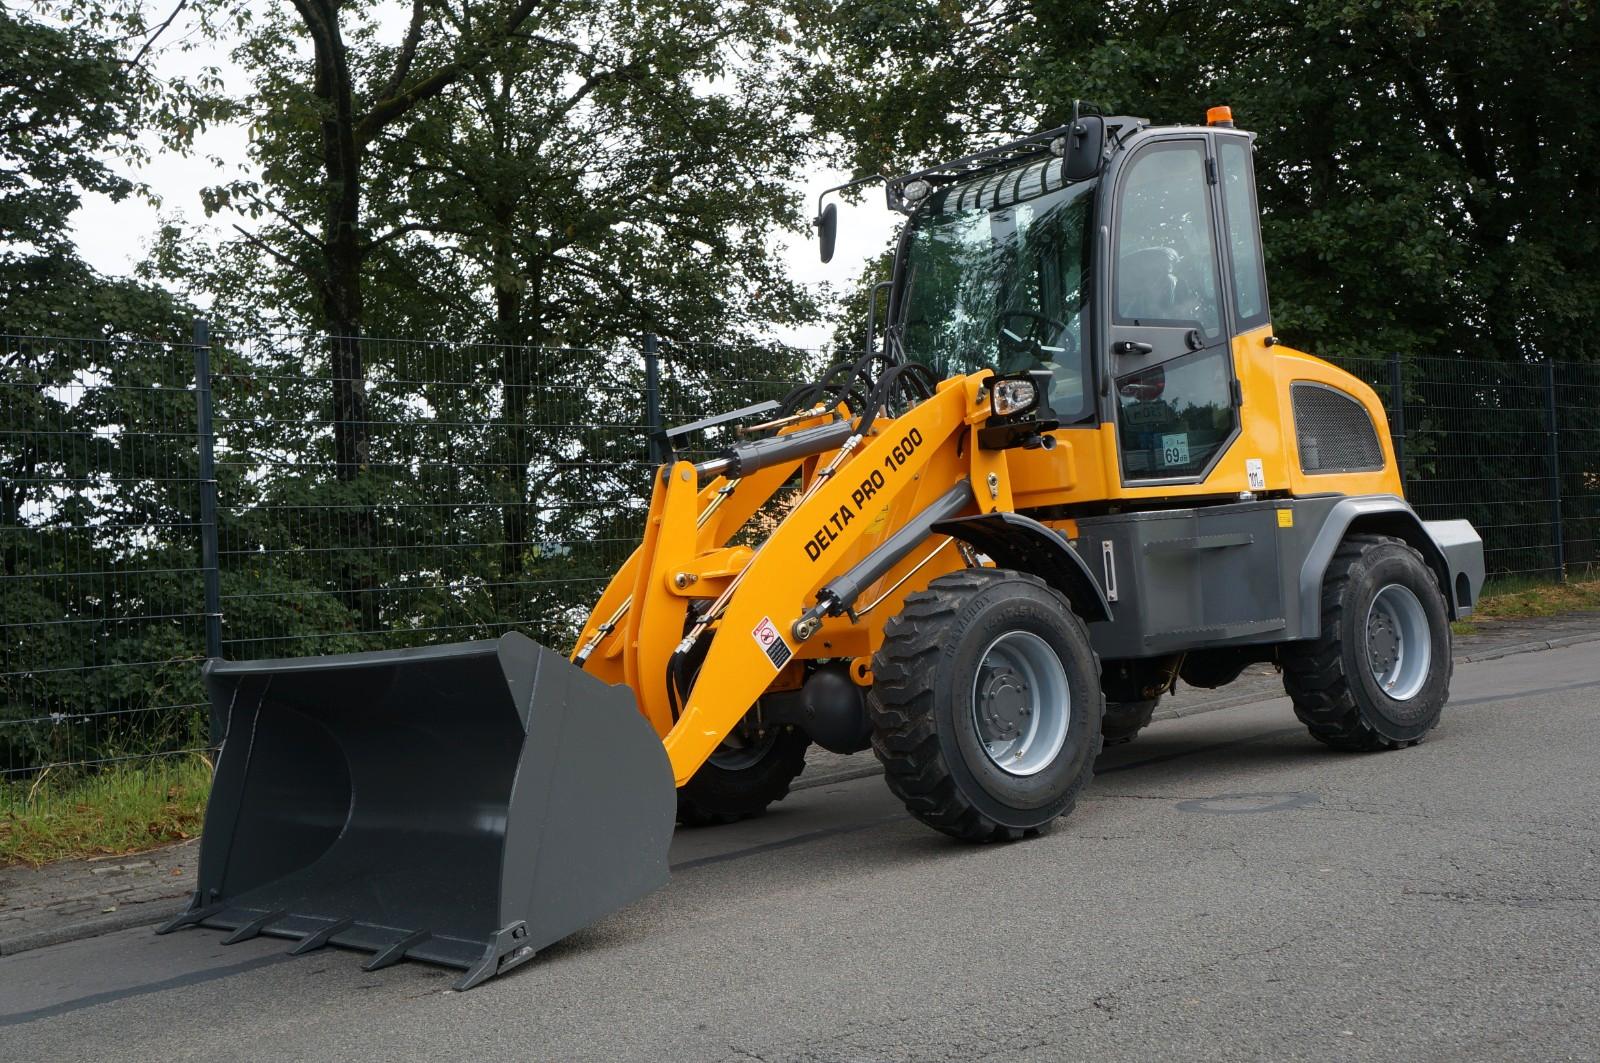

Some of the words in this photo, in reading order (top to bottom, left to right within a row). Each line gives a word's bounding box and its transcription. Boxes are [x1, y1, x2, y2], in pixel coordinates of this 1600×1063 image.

[1165, 447, 1180, 463] 69
[803, 504, 855, 562] DELTA
[851, 469, 885, 510] PRO
[884, 427, 923, 472] 1600
